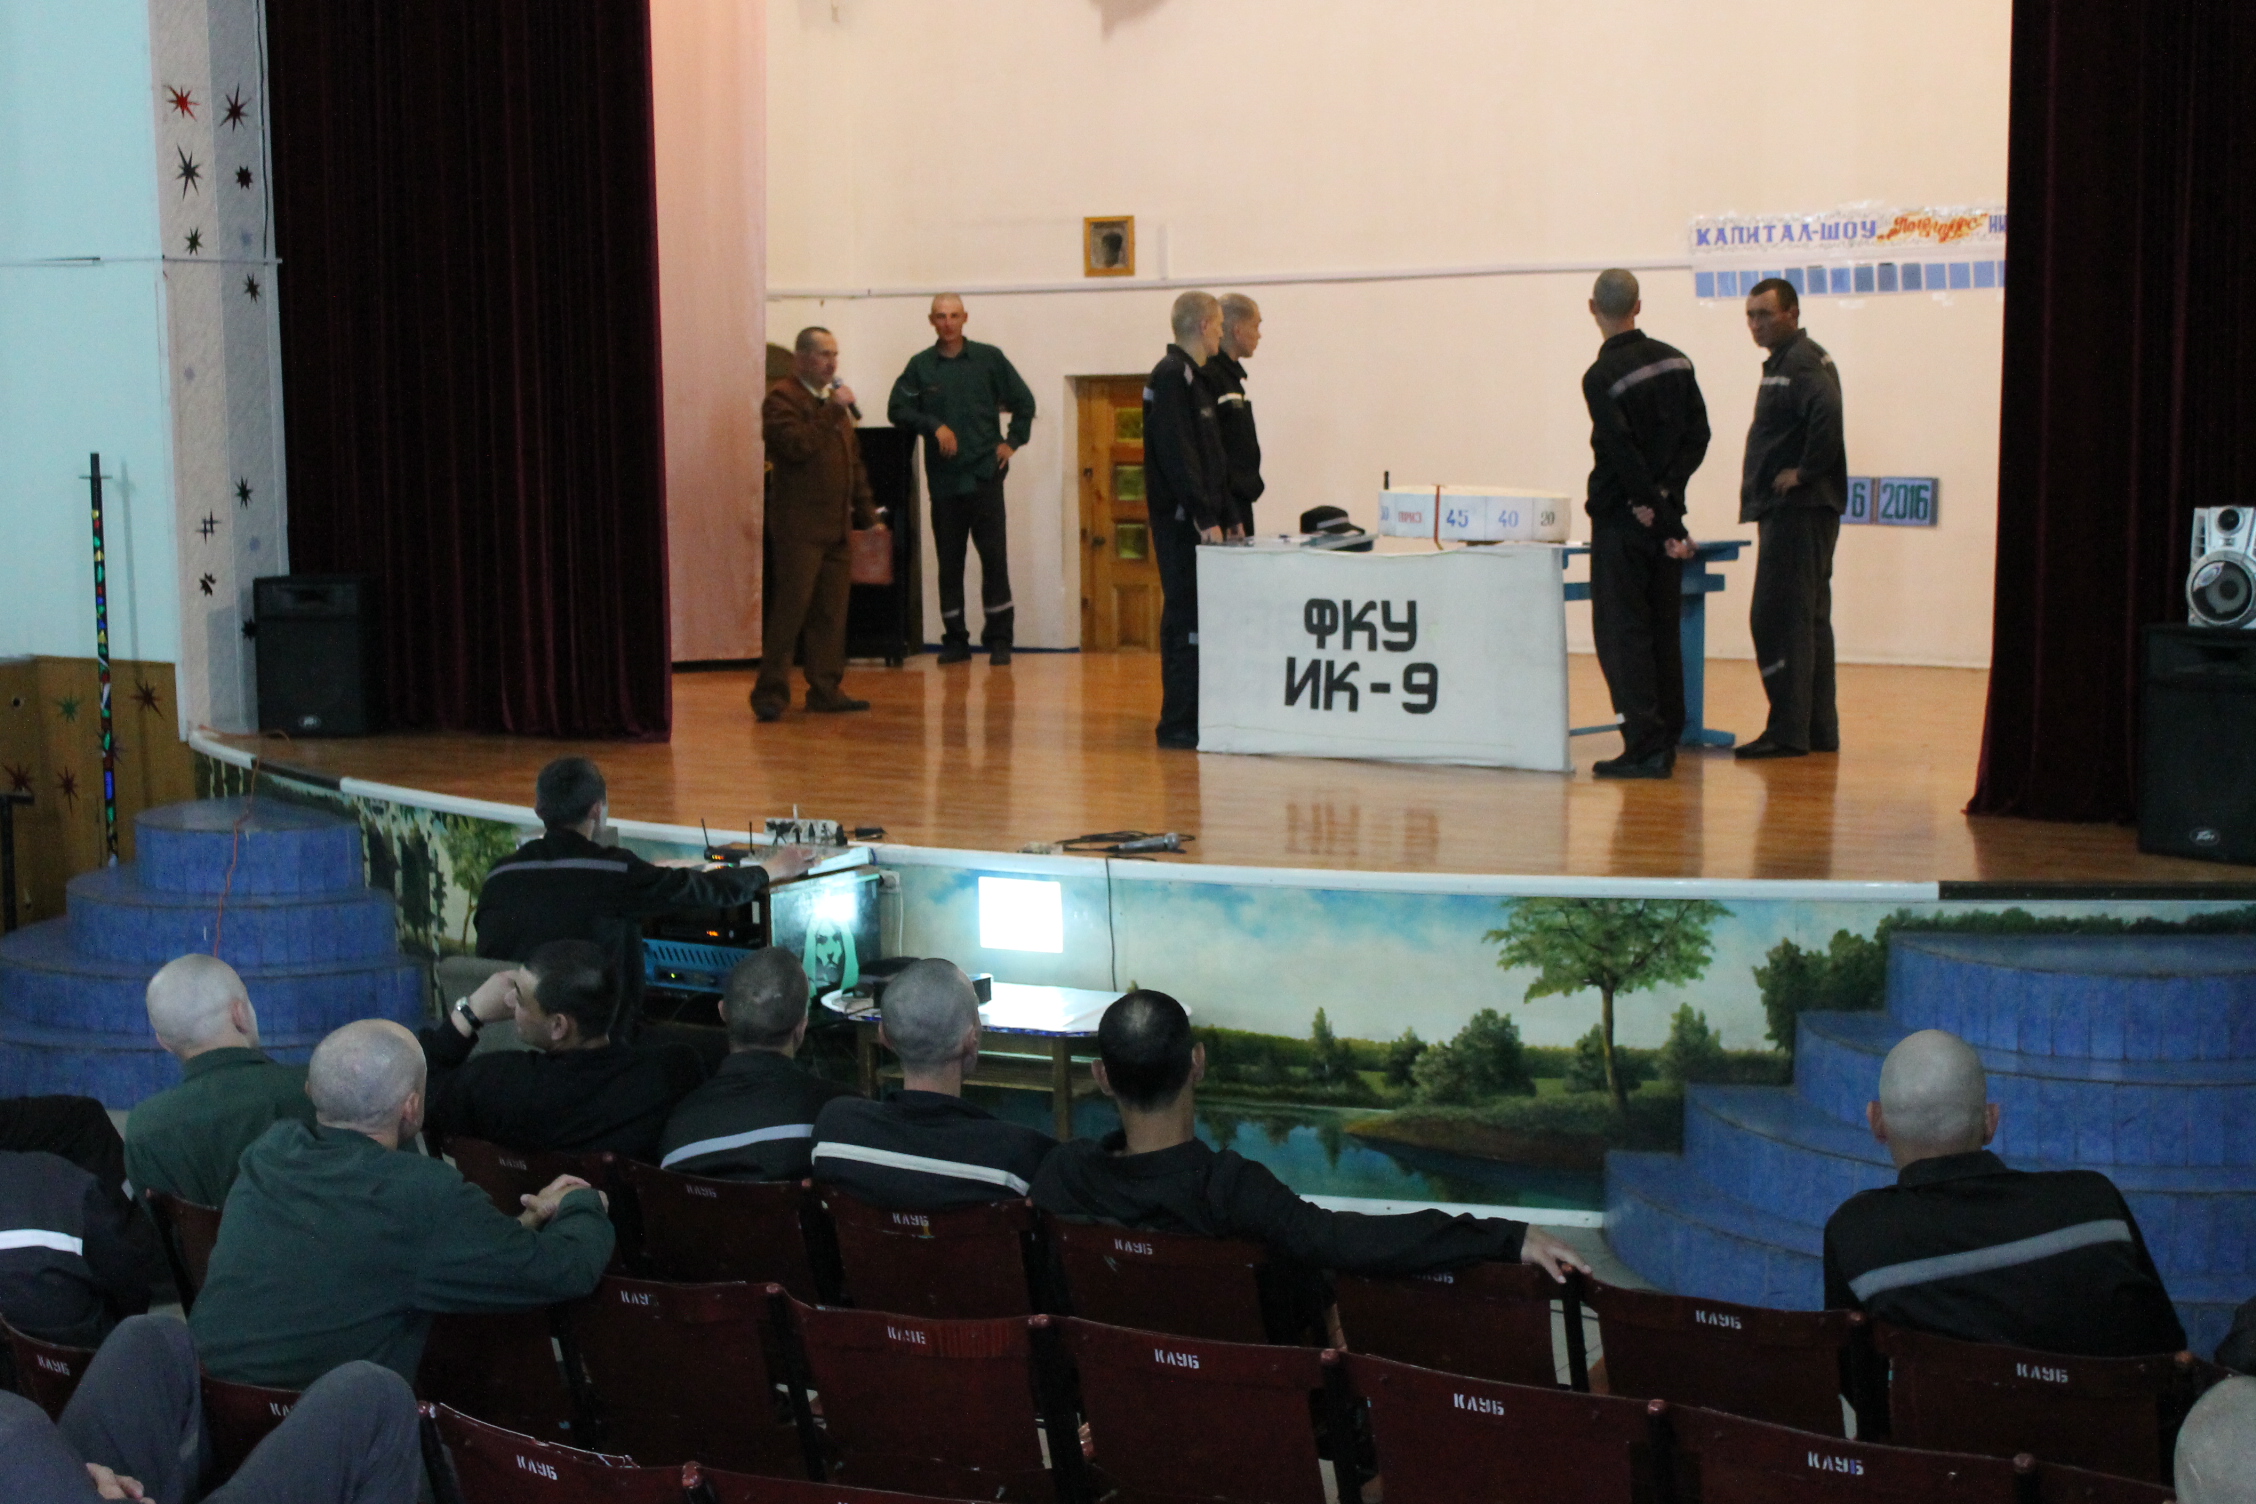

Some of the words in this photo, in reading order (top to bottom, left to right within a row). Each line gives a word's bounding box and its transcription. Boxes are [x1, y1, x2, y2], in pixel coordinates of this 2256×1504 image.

[1696, 219, 1876, 246] КАПИТАЛ-ШОУ
[1881, 482, 1930, 520] 2016
[1446, 509, 1470, 528] 45
[1498, 510, 1520, 528] 40
[1304, 598, 1417, 652] ФКУ
[1284, 656, 1439, 714] ИК-9
[892, 1212, 930, 1227] КЛУБ
[1114, 1238, 1153, 1255] КЛУБ
[1695, 1309, 1742, 1330] КЛУБ
[1154, 1348, 1200, 1369] КЛУБ
[2016, 1362, 2069, 1383] КЛУБ
[1453, 1393, 1505, 1416] КЛУБ
[516, 1454, 558, 1481] КЛУБ
[1807, 1451, 1864, 1475] КЛУБ
